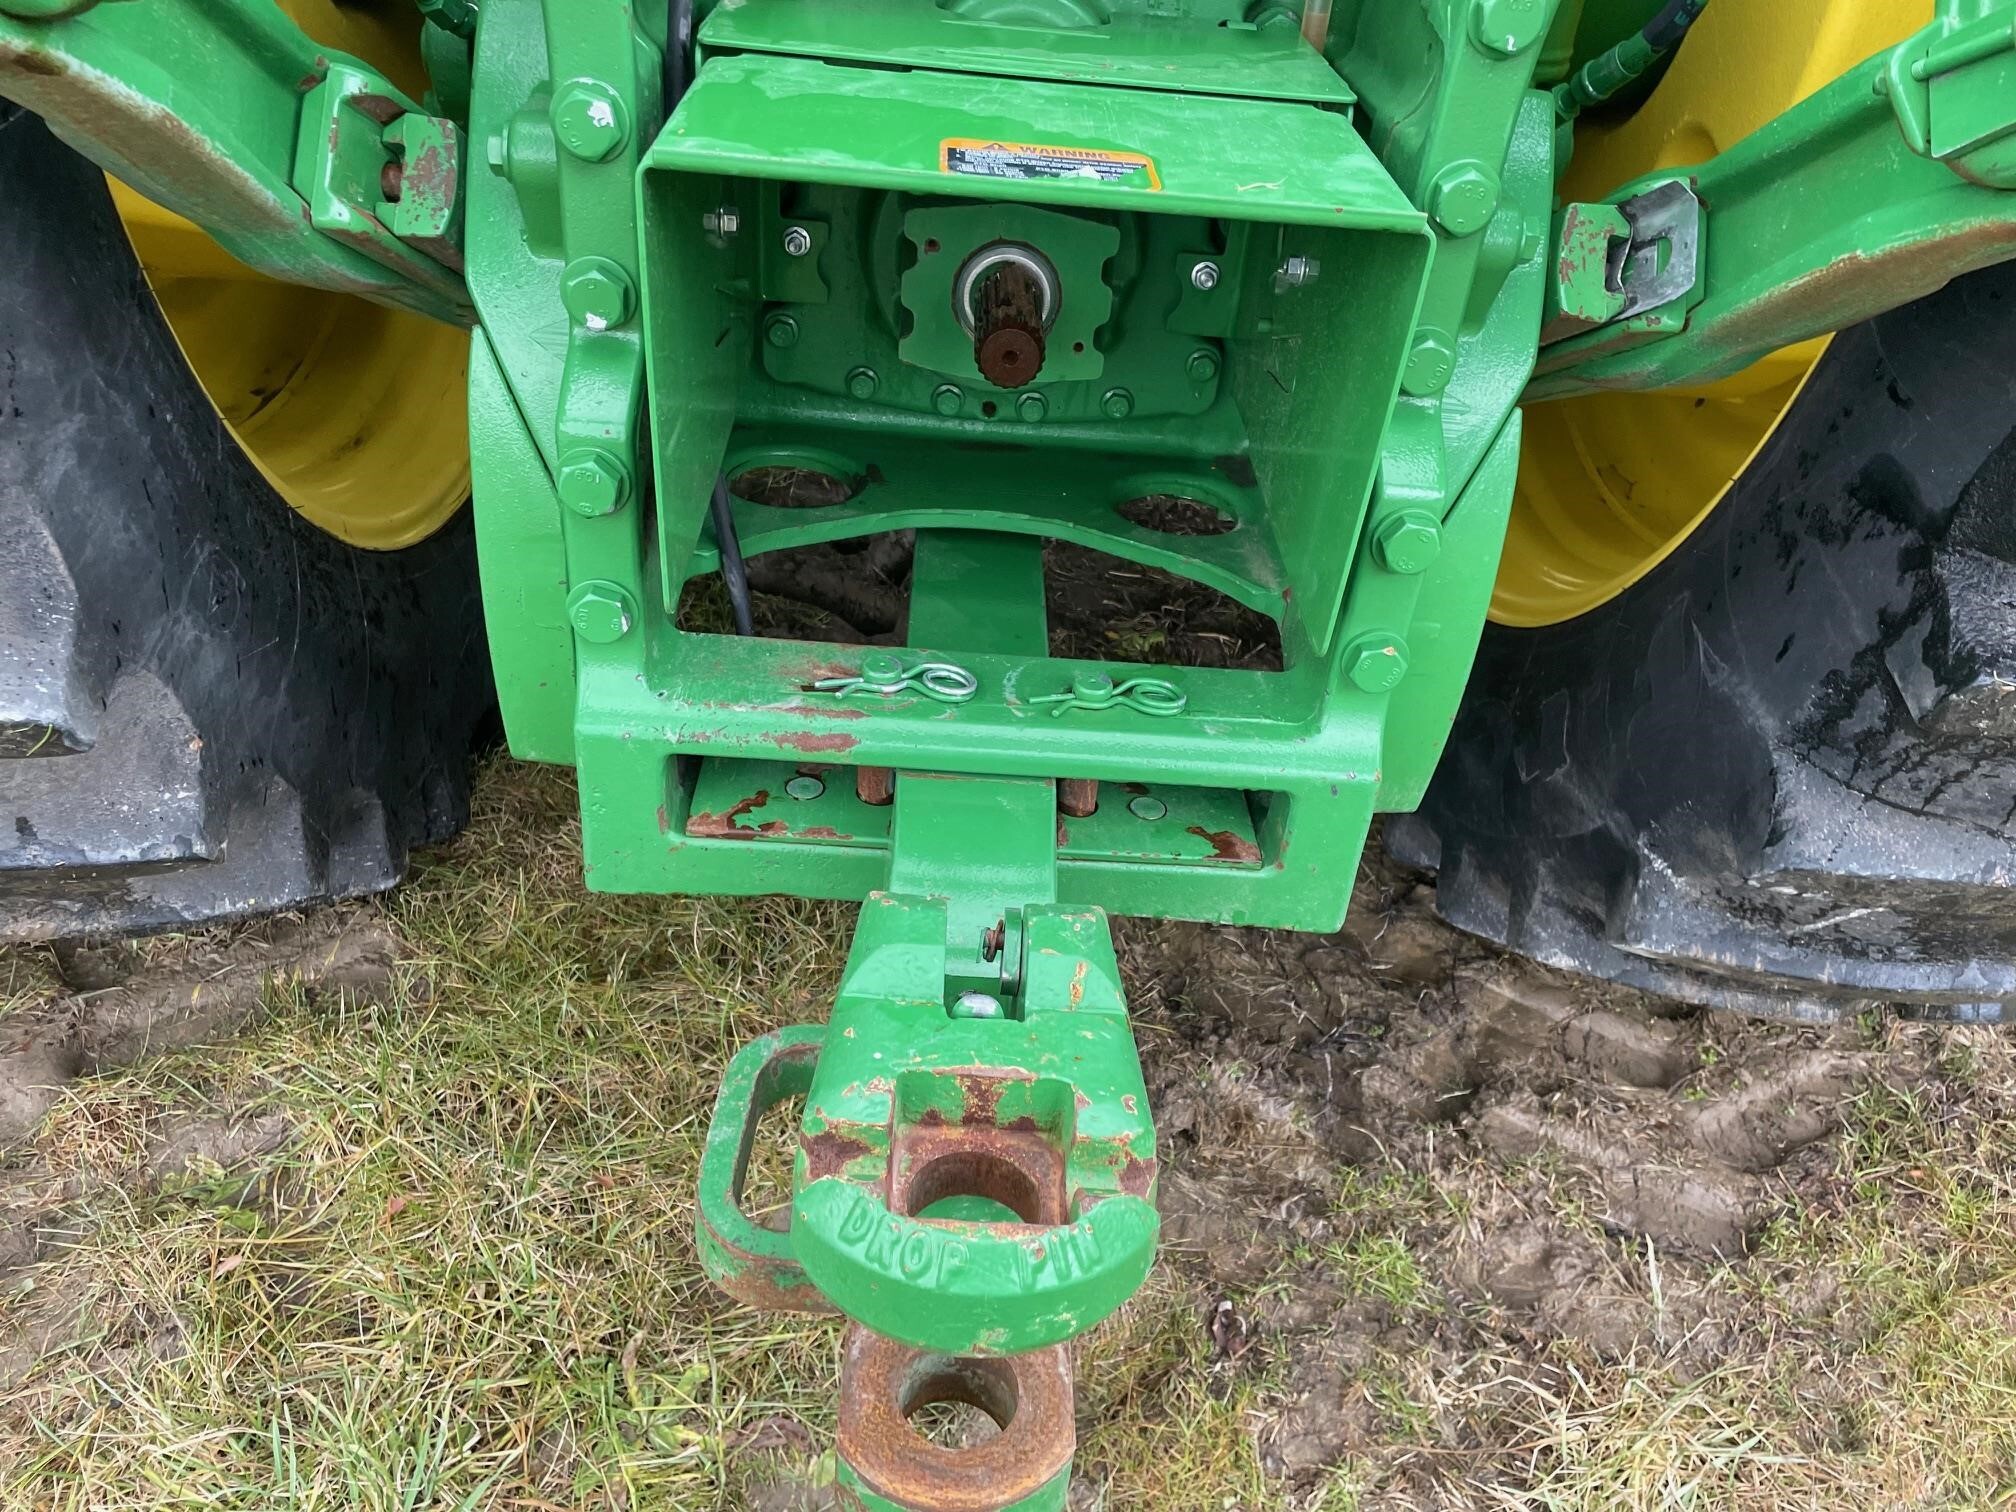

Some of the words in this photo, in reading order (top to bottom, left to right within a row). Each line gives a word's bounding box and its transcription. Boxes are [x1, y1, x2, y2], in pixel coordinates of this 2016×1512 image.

[1019, 146, 1111, 160] WARNING
[838, 1195, 970, 1290] DROP
[1018, 1222, 1102, 1290] PIN
